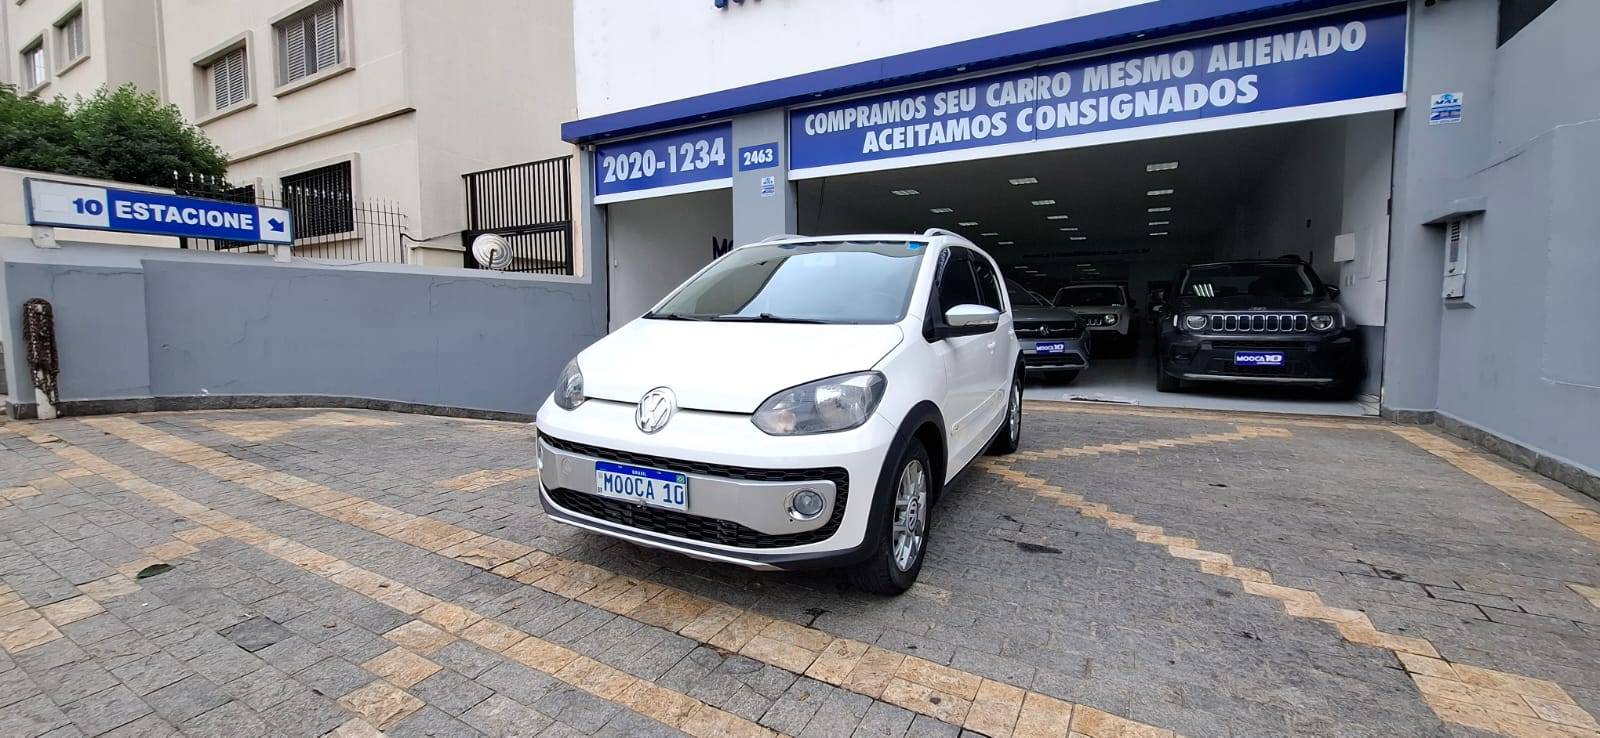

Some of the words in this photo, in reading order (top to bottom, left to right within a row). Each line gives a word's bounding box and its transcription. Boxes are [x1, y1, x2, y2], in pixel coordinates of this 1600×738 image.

[805, 96, 926, 136] COMPRAMOS
[933, 87, 977, 116] SEU
[986, 72, 1071, 107] CARRO
[1082, 50, 1195, 92] MESMO
[1207, 21, 1367, 73] ALIENADO
[862, 112, 1008, 153] ACEITAMOS
[1016, 75, 1258, 132] CONSIGNADOS
[603, 137, 725, 183] 2020-1234
[743, 149, 773, 166] 2463
[73, 198, 103, 216] 10
[115, 200, 254, 230] ESTACIONE
[603, 473, 655, 500] MOOCA
[663, 483, 684, 505] 10
